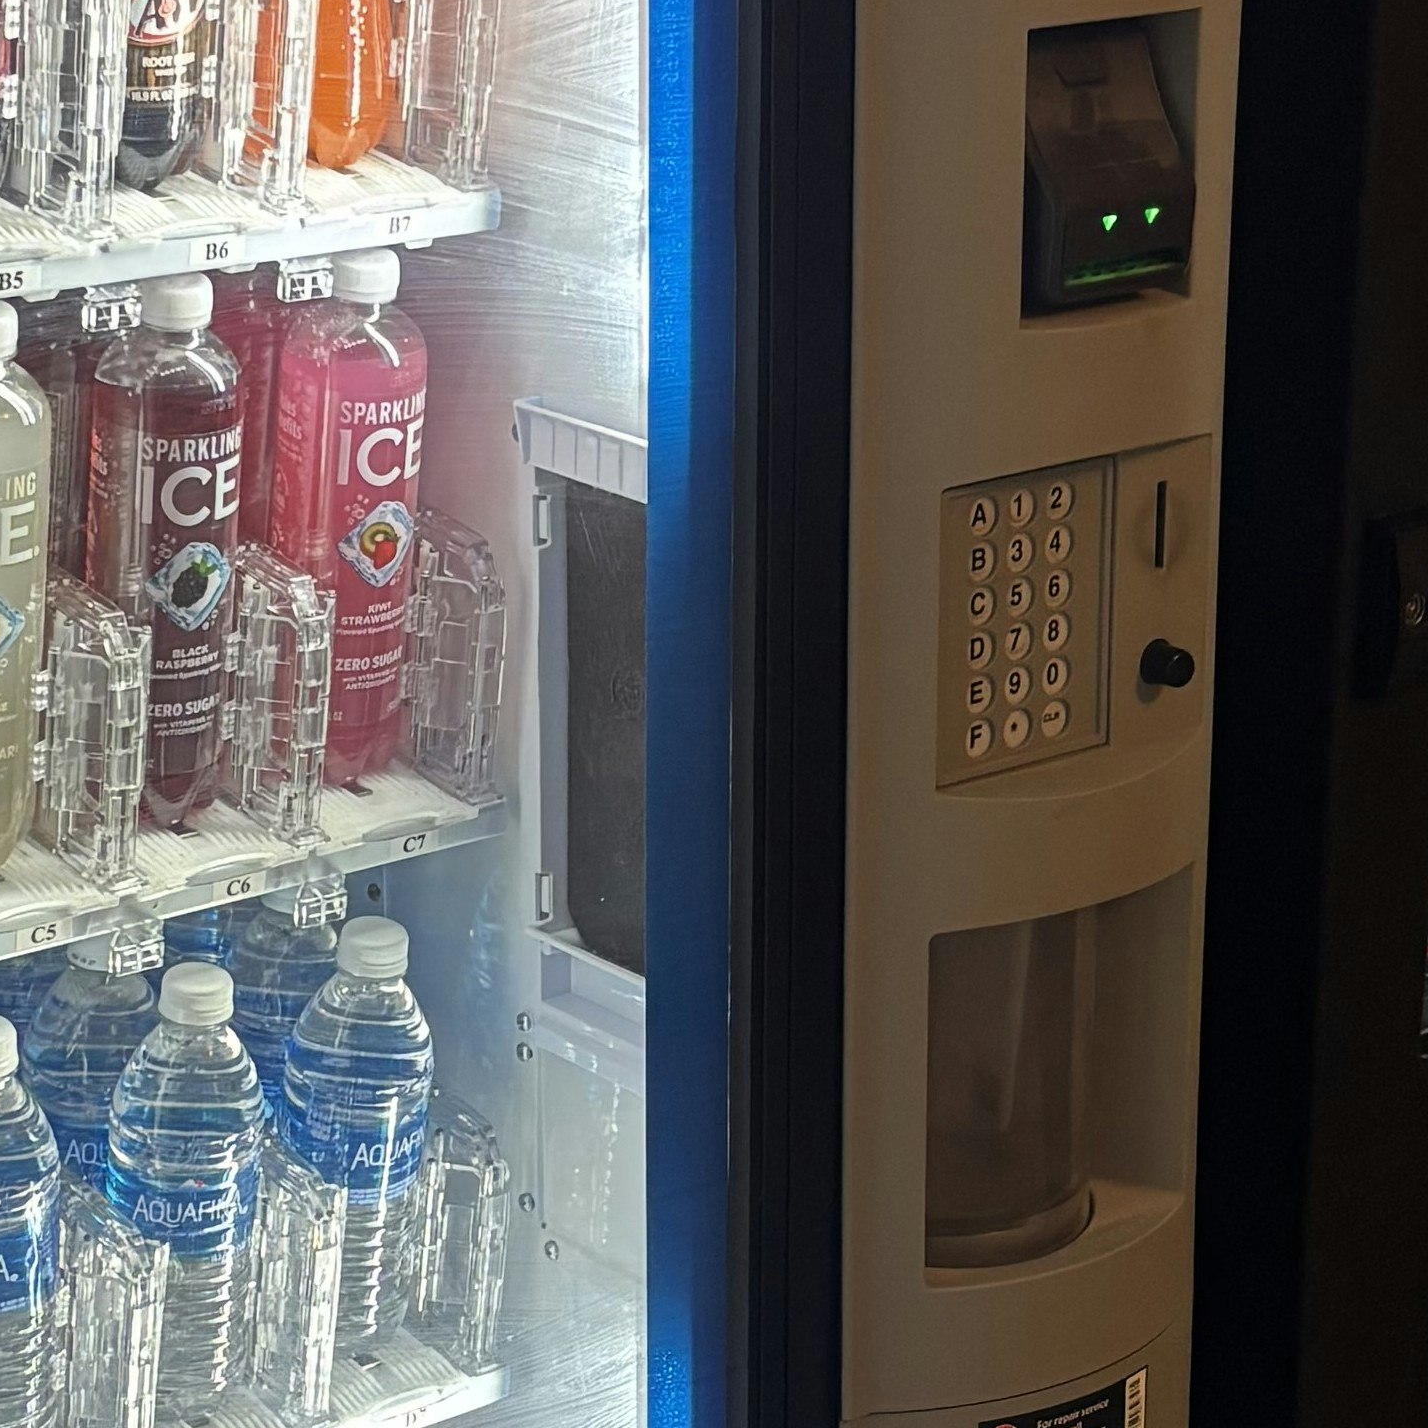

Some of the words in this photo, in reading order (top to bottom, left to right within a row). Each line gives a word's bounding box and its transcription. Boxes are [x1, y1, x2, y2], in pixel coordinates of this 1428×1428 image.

[388, 213, 412, 235] B7
[203, 239, 230, 261] B6
[142, 426, 243, 463] SPARKLING
[336, 415, 424, 487] ICE
[141, 454, 241, 527] ICE
[972, 503, 987, 527] A
[1013, 495, 1023, 517] 1
[1051, 487, 1062, 509] 2
[972, 547, 985, 572] B
[1011, 539, 1023, 562] 3
[1049, 531, 1061, 553] 4
[971, 592, 985, 615] C
[1010, 583, 1022, 605] 5
[1049, 575, 1060, 597] 6
[368, 602, 392, 615] KIWI
[970, 637, 984, 660] D
[1010, 628, 1022, 650] 7
[1048, 619, 1059, 641] 8
[156, 651, 219, 670] RASPBERRY
[172, 644, 209, 659] BLACK
[335, 655, 371, 673] ZERO
[970, 681, 983, 704] E
[1009, 672, 1021, 694] 9
[1047, 663, 1058, 685] 0
[147, 701, 183, 718] ZERO
[970, 725, 982, 749] F
[403, 834, 426, 853] C7
[226, 879, 251, 897] C6
[30, 925, 57, 945] C5
